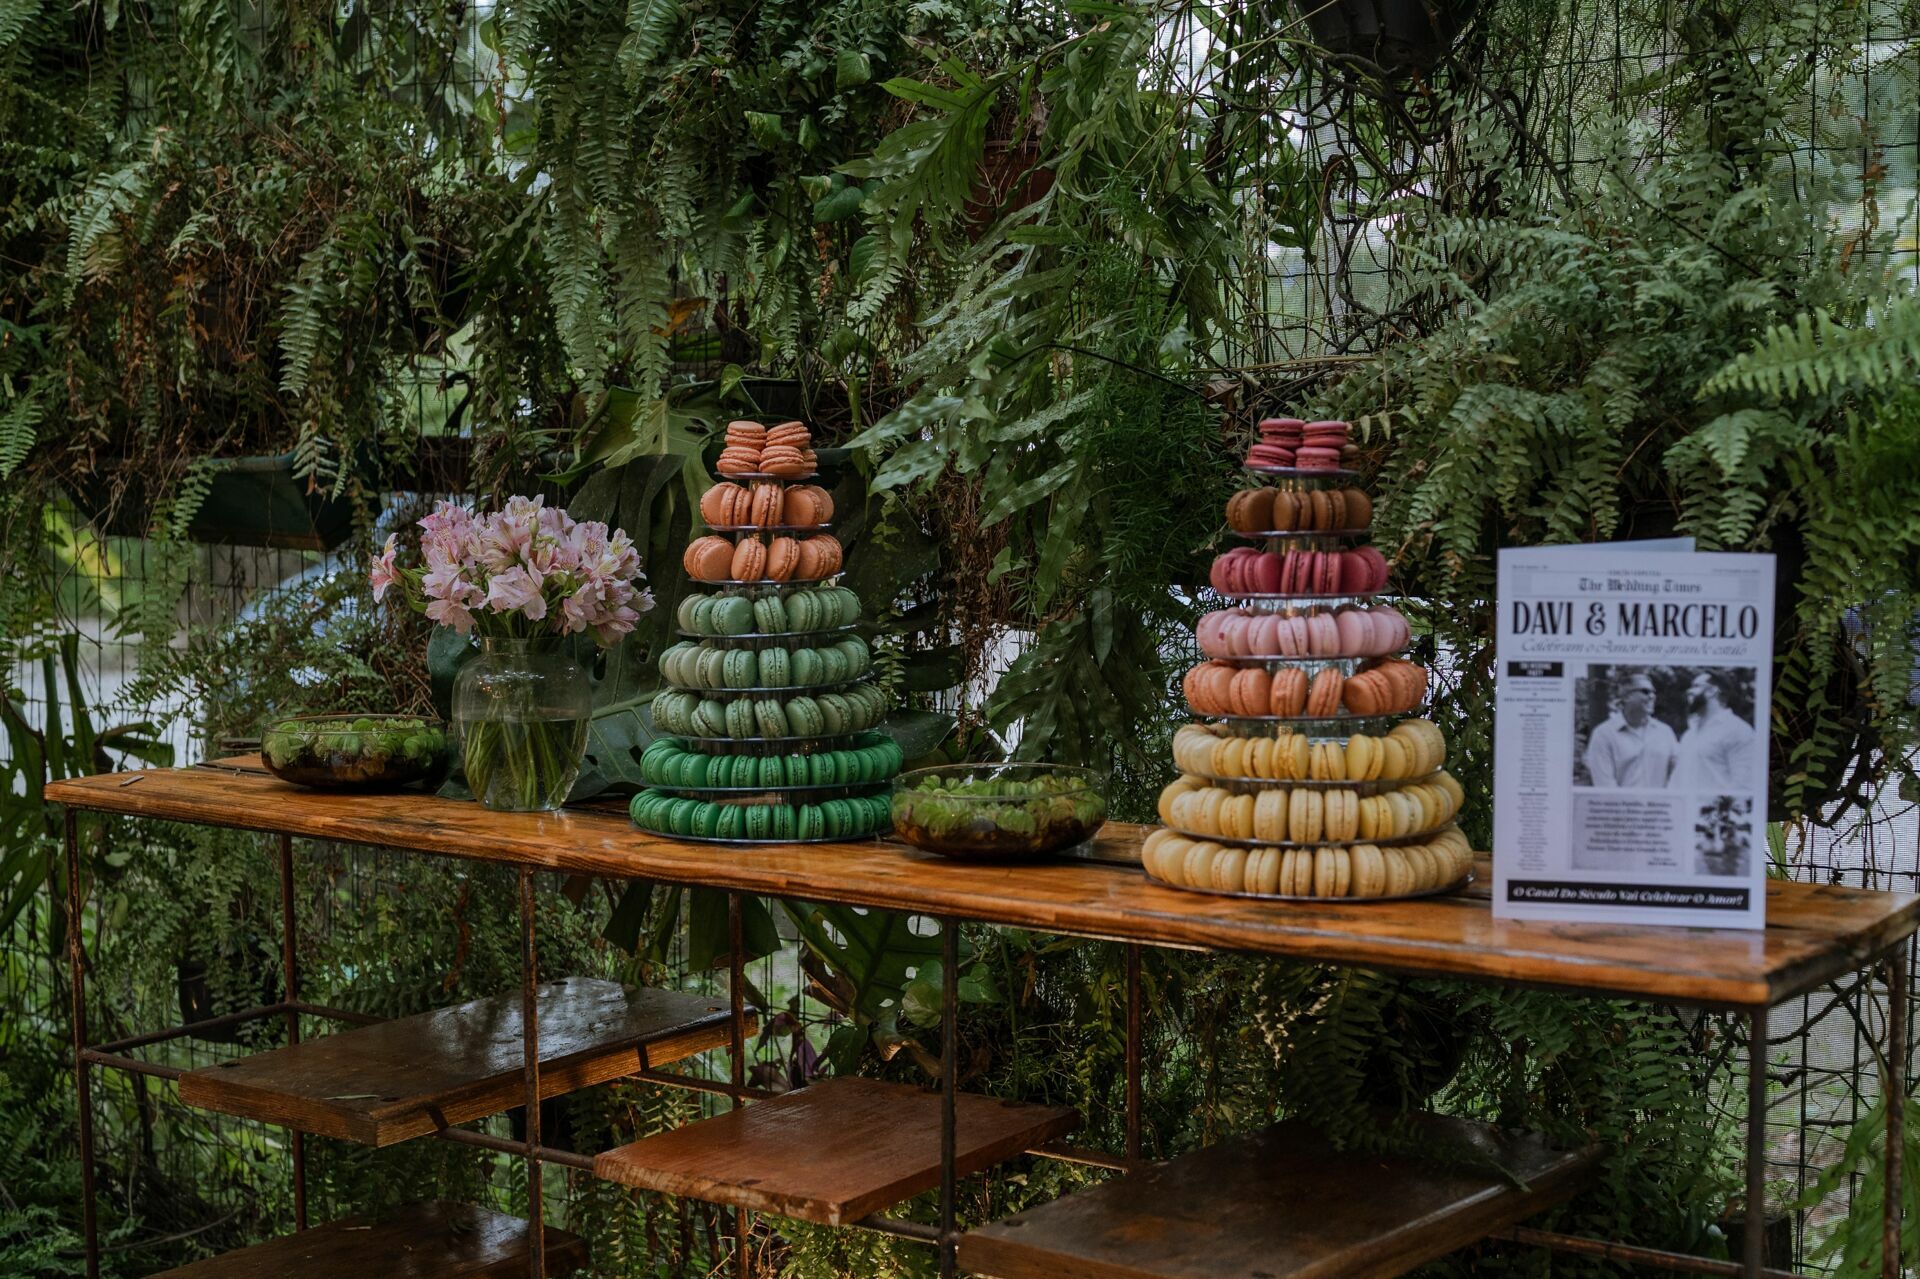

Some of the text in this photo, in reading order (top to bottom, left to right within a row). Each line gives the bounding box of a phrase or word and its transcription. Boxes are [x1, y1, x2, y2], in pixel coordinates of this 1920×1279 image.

[1579, 577, 1702, 595] The Wedding Times
[1512, 601, 1759, 640] DAVI & MARCELO
[1526, 886, 1559, 898] Casal
